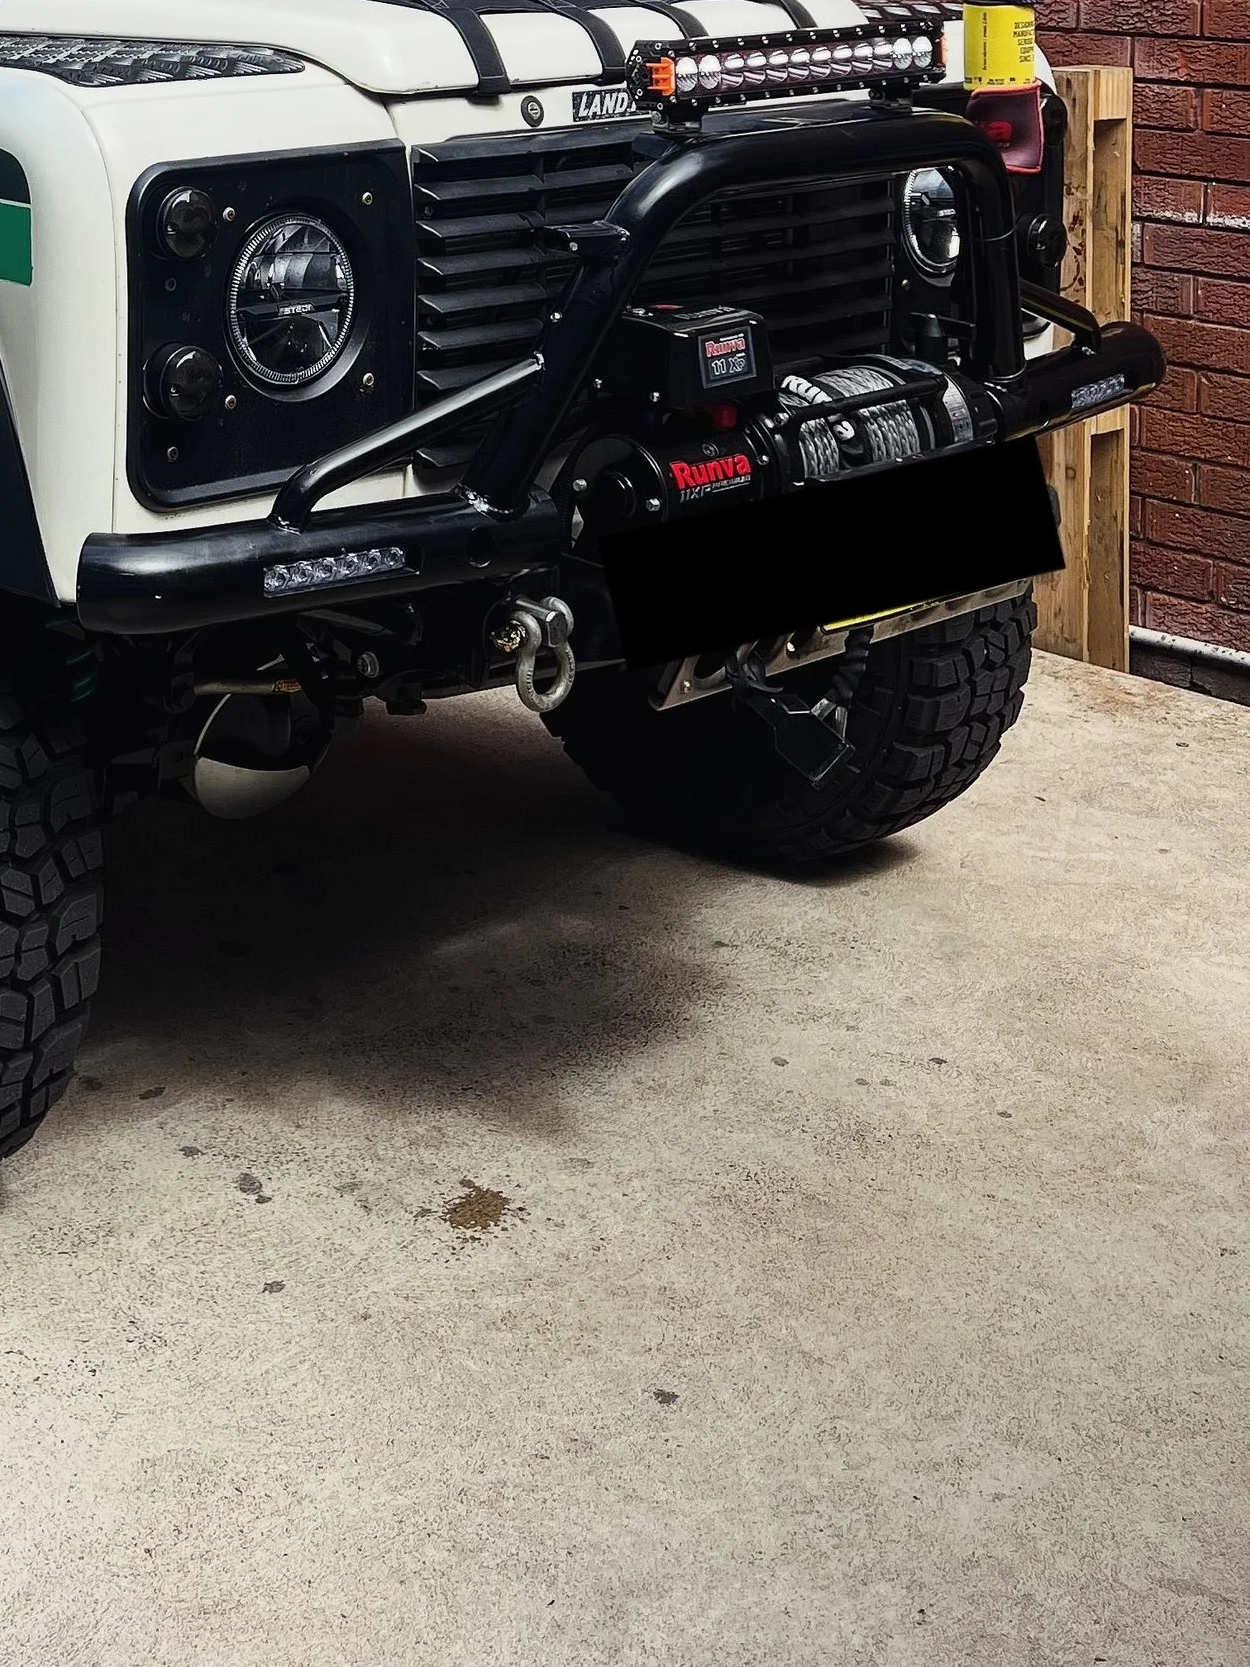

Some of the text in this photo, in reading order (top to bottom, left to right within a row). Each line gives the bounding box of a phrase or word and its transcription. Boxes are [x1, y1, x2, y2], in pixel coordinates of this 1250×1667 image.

[578, 91, 629, 118] LAND
[705, 337, 746, 358] Runva
[711, 358, 727, 375] 11
[669, 452, 752, 491] Runva
